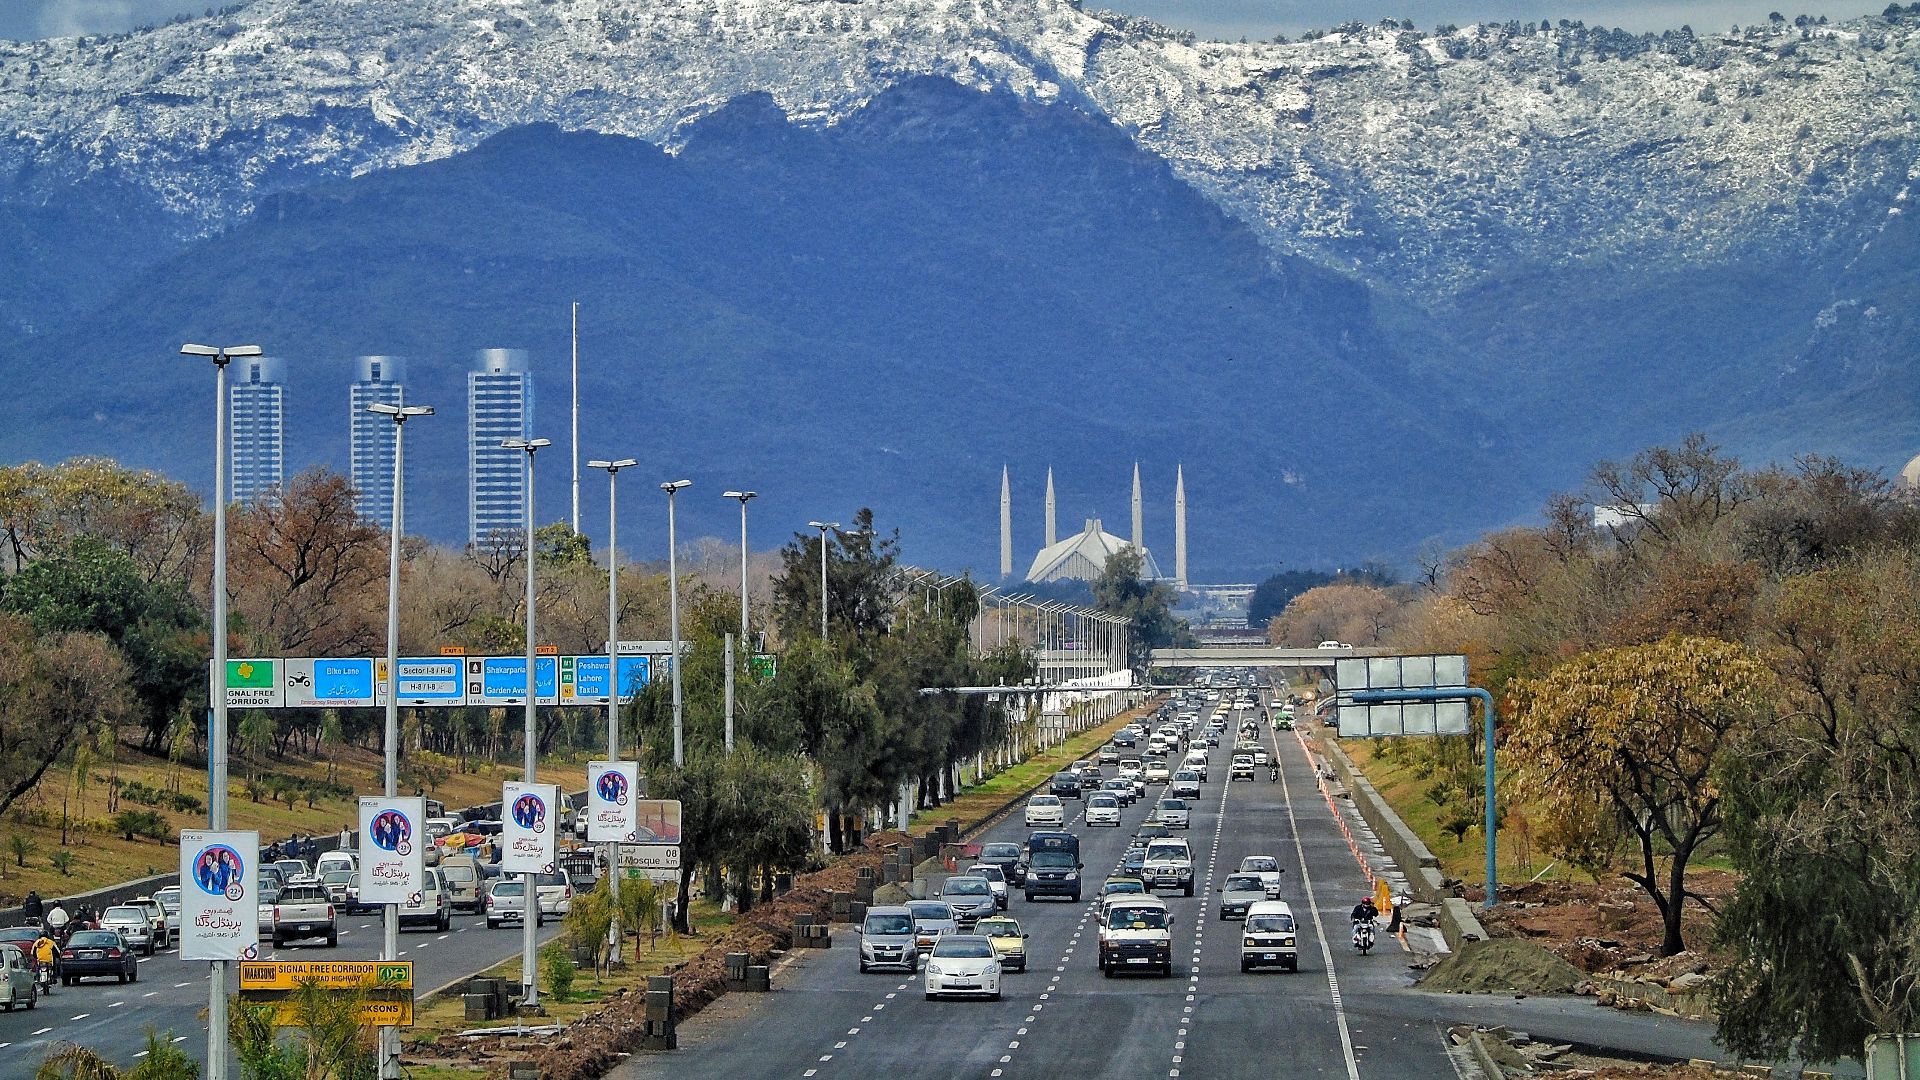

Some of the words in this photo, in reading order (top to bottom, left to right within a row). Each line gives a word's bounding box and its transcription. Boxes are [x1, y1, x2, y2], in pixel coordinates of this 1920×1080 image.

[326, 667, 342, 675] Bike
[343, 667, 360, 675] Lane
[625, 856, 660, 866] Mosque
[278, 965, 307, 974] SIGNAL
[332, 965, 374, 973] CORRIDOR
